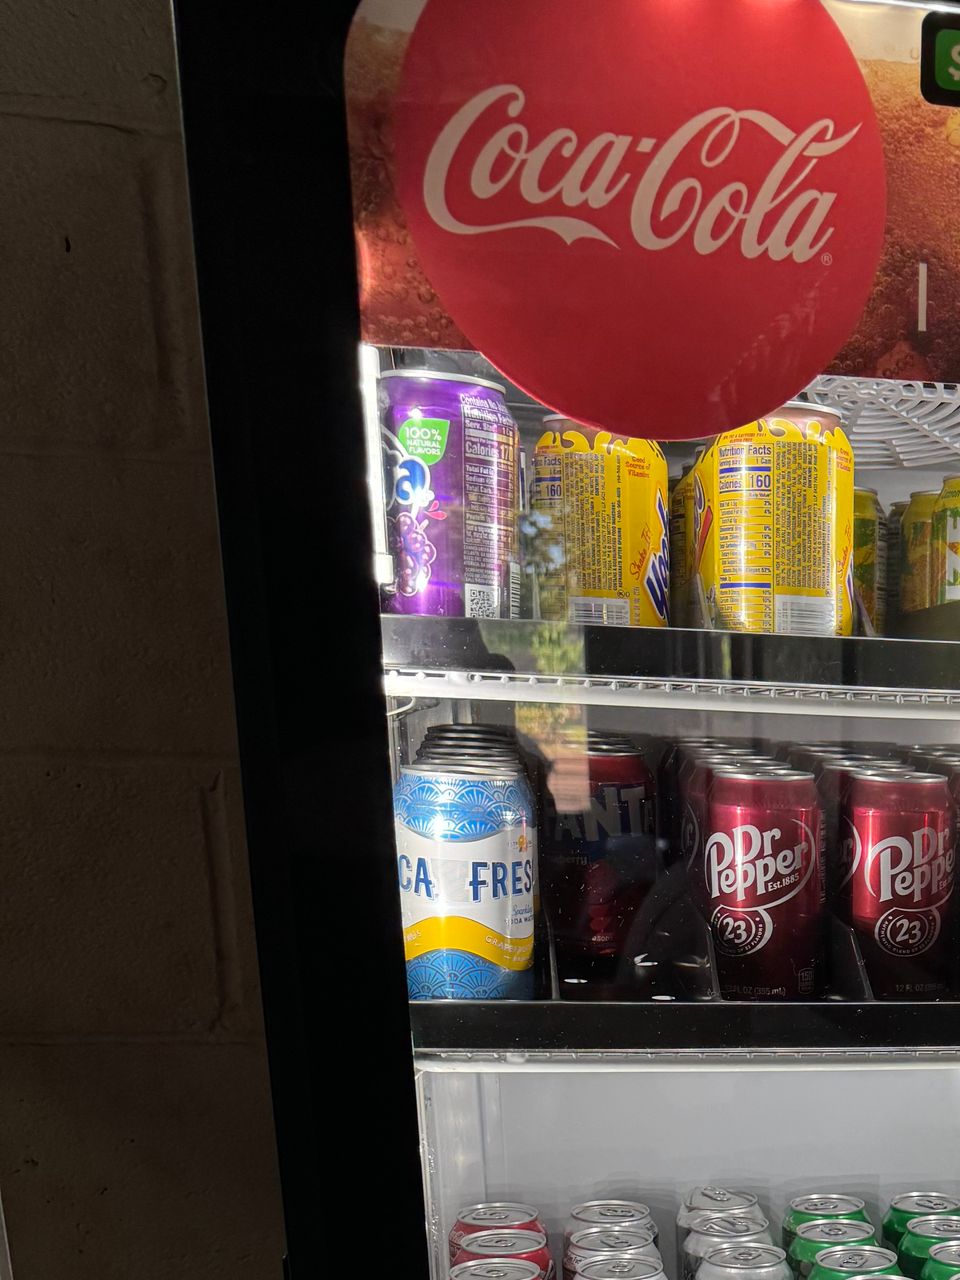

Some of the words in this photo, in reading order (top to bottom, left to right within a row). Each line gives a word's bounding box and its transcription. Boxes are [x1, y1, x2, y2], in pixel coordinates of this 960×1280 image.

[423, 84, 864, 264] Coca-Cola
[404, 426, 442, 441] 100%
[406, 441, 442, 450] NATURAL
[408, 448, 441, 457] FLAVORS
[748, 445, 772, 456] Facts
[545, 483, 562, 498] 160
[750, 474, 772, 489] 160
[732, 824, 781, 864] Dr
[911, 826, 950, 868] Dr
[704, 831, 810, 902] Pepper
[723, 917, 748, 944] 23
[896, 918, 922, 944] 23
